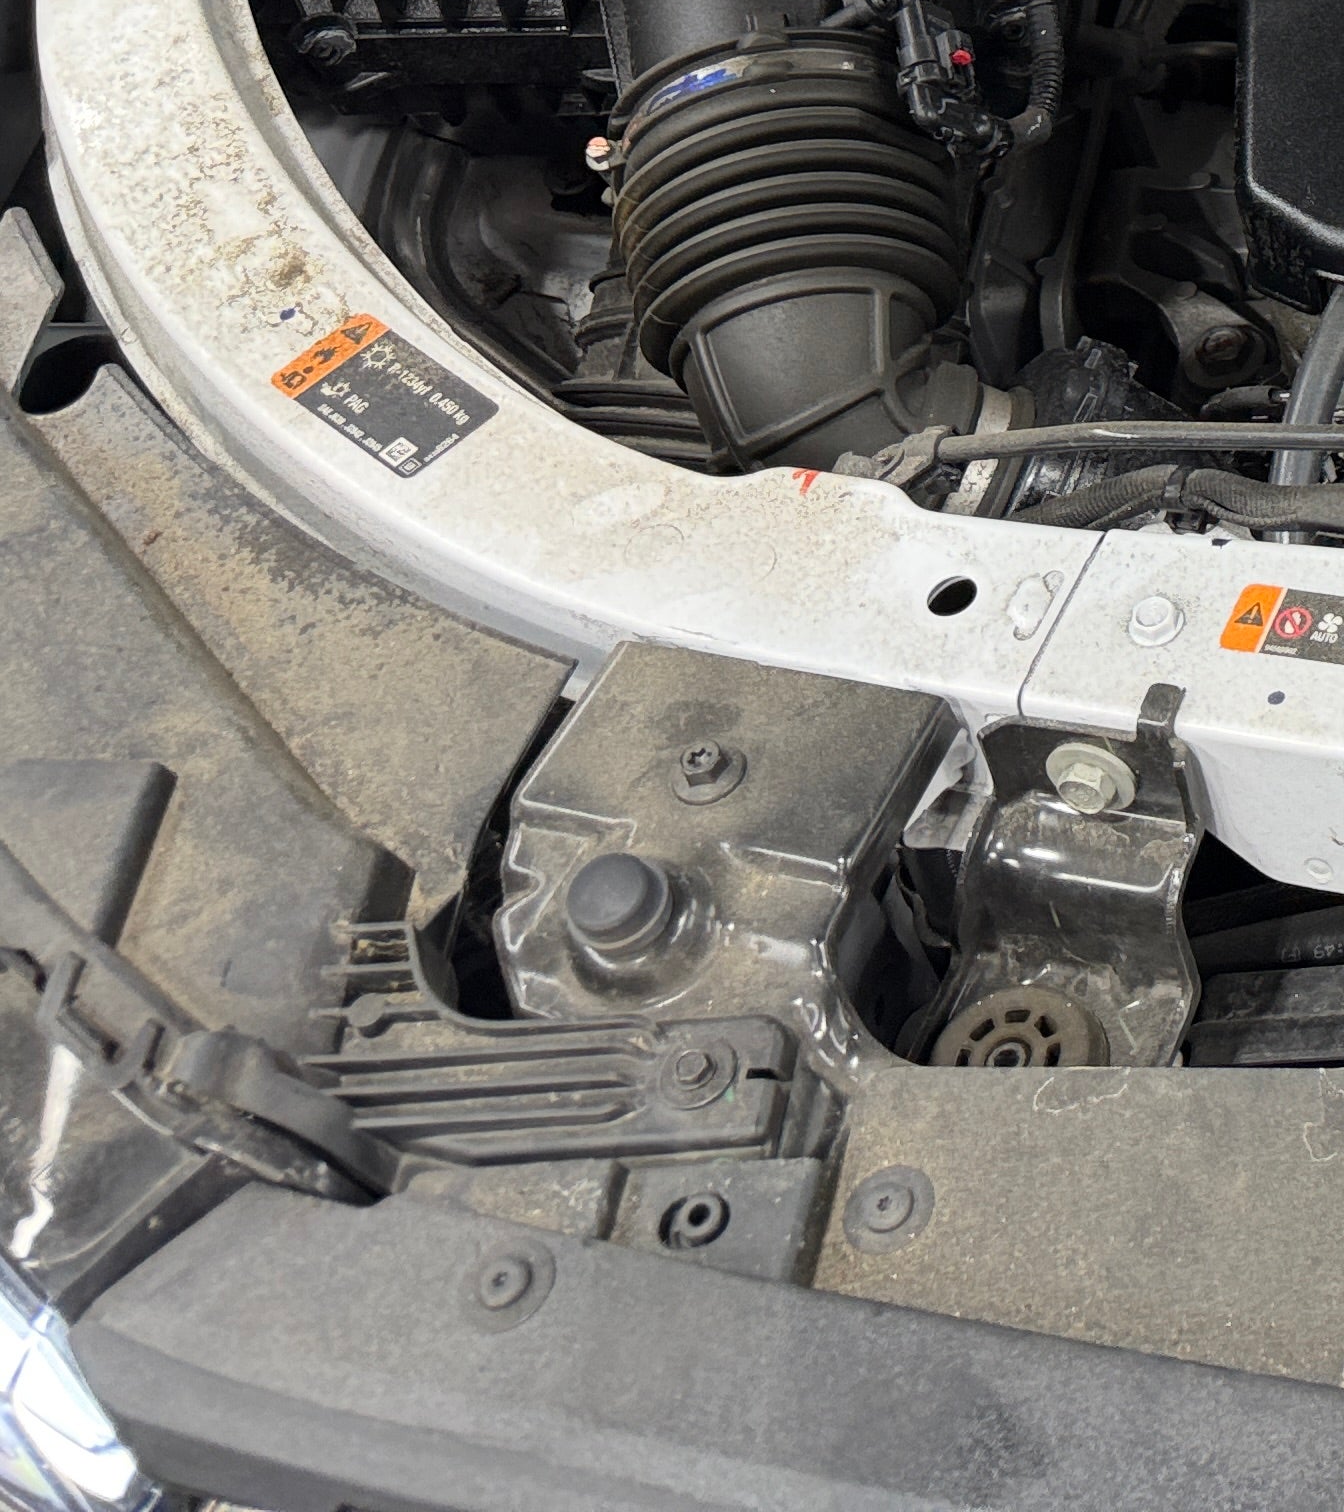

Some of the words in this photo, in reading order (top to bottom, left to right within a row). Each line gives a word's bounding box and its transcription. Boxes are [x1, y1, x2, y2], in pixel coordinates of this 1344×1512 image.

[343, 393, 370, 415] PAG
[387, 362, 433, 396] R-1234yf
[428, 392, 460, 416] 0.450
[453, 409, 472, 426] kg
[1310, 630, 1339, 644] AUTO
